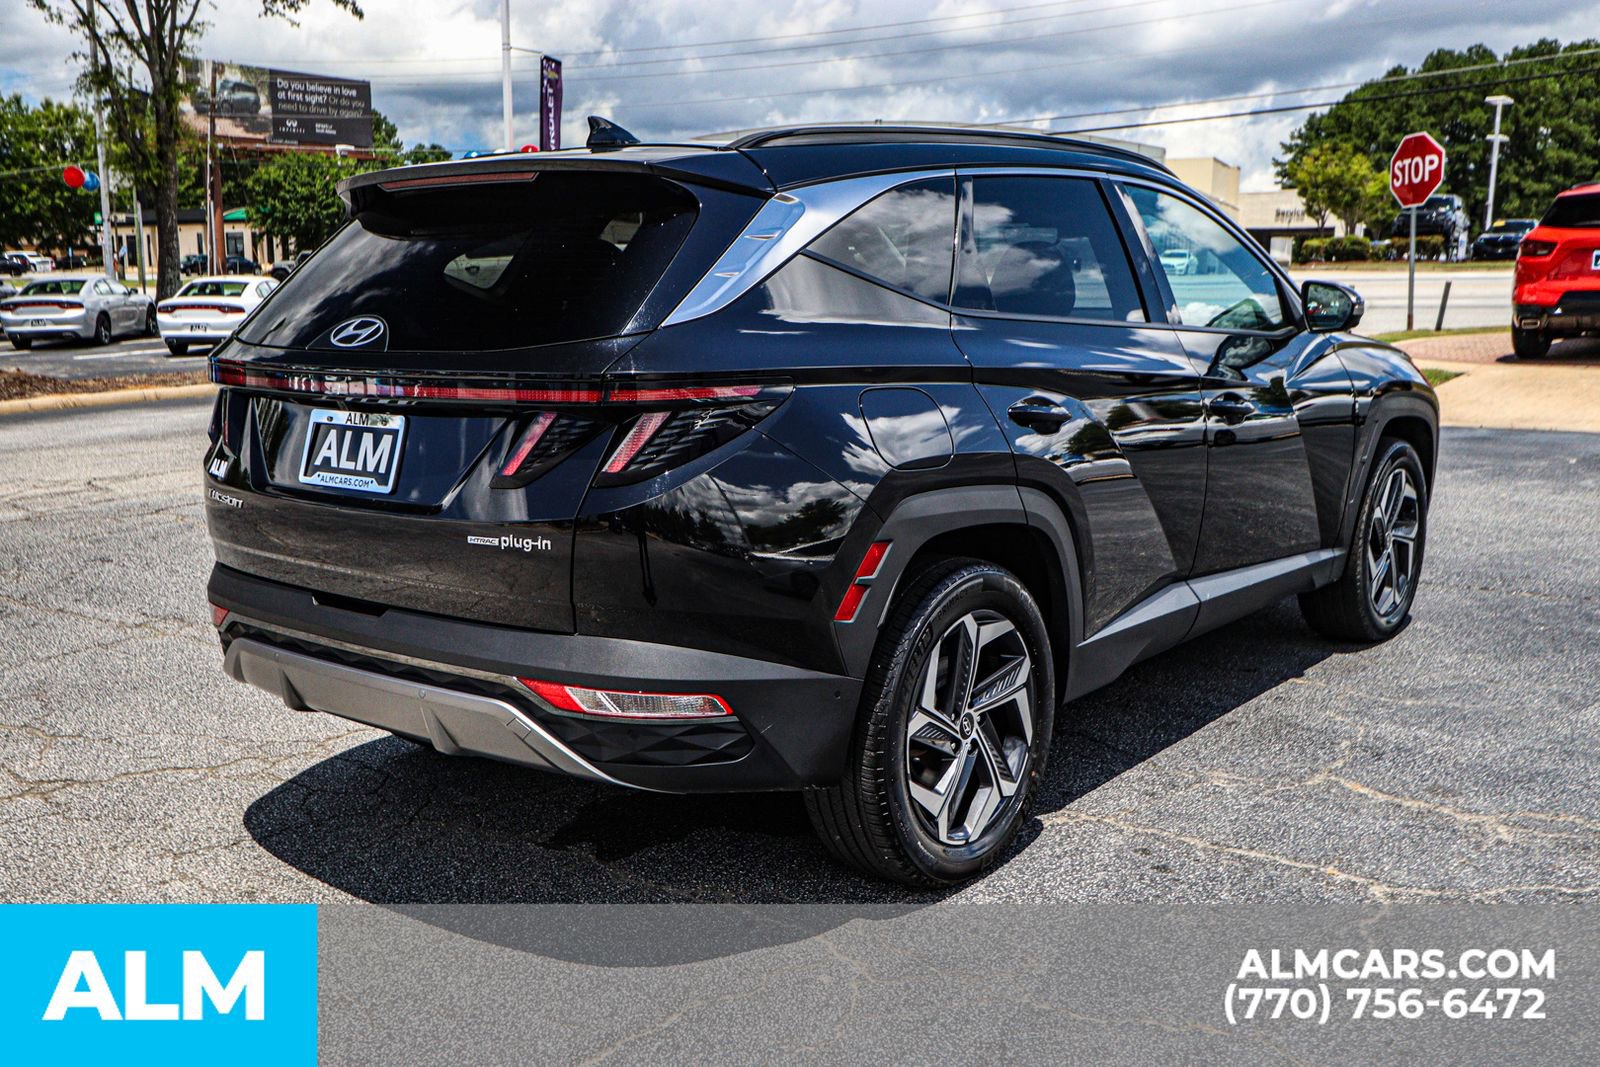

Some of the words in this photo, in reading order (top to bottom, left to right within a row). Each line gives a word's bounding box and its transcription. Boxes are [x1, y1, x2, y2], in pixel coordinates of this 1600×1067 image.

[277, 78, 288, 89] Do
[290, 81, 304, 91] you
[306, 82, 332, 95] believe
[333, 85, 341, 95] in
[342, 86, 357, 97] love
[277, 91, 286, 100] at
[288, 91, 303, 101] first
[305, 93, 327, 105] sight?
[340, 96, 350, 105] do
[351, 99, 365, 108] you
[278, 102, 297, 110] need
[299, 103, 307, 112] to
[309, 104, 327, 114] drive
[329, 106, 338, 117] by
[339, 108, 362, 118] again?
[1393, 154, 1439, 187] STOP
[345, 412, 369, 426] ALM
[313, 428, 393, 474] ALM
[209, 457, 228, 479] ALM
[320, 475, 370, 488] ALMCARS.COM
[501, 534, 551, 552] plug-in
